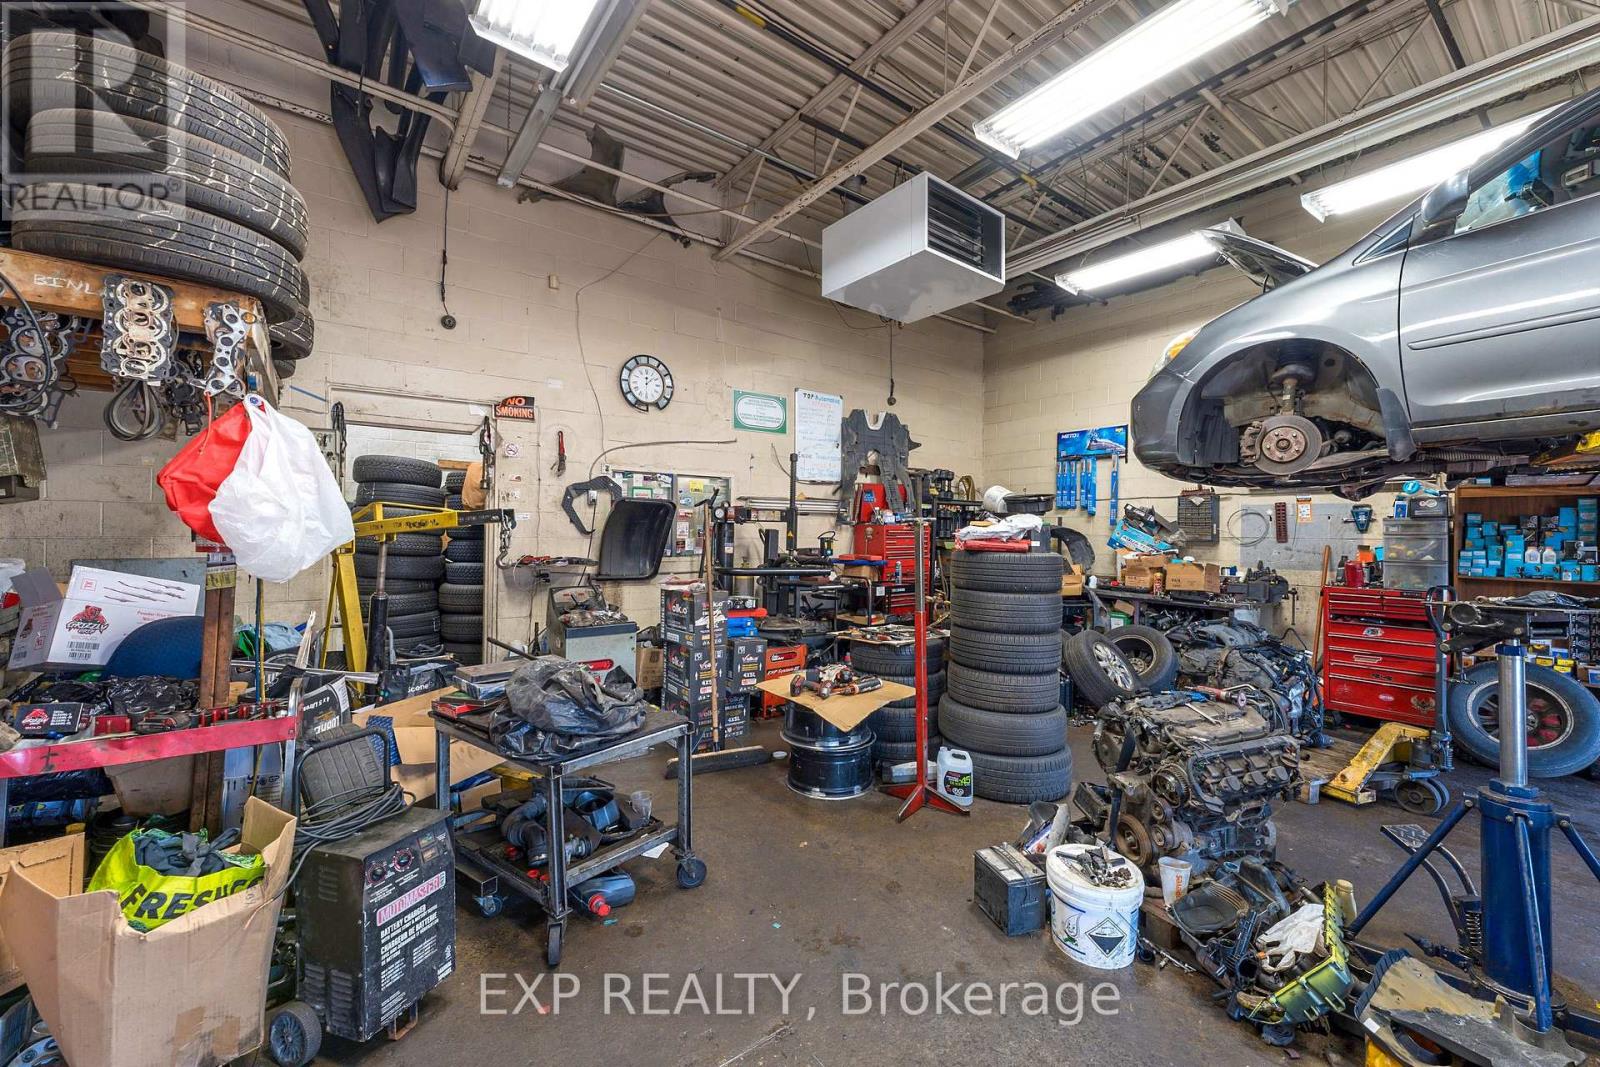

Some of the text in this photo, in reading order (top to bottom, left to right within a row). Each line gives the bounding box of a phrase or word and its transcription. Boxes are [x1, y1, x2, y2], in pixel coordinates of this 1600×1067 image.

[495, 405, 533, 419] SMOKING
[506, 397, 526, 406] NO
[380, 917, 403, 938] BATTERY
[403, 903, 427, 924] CHARGER
[380, 931, 408, 955] CHARGEUR
[408, 926, 416, 937] DE
[415, 911, 438, 932] BATTERIE
